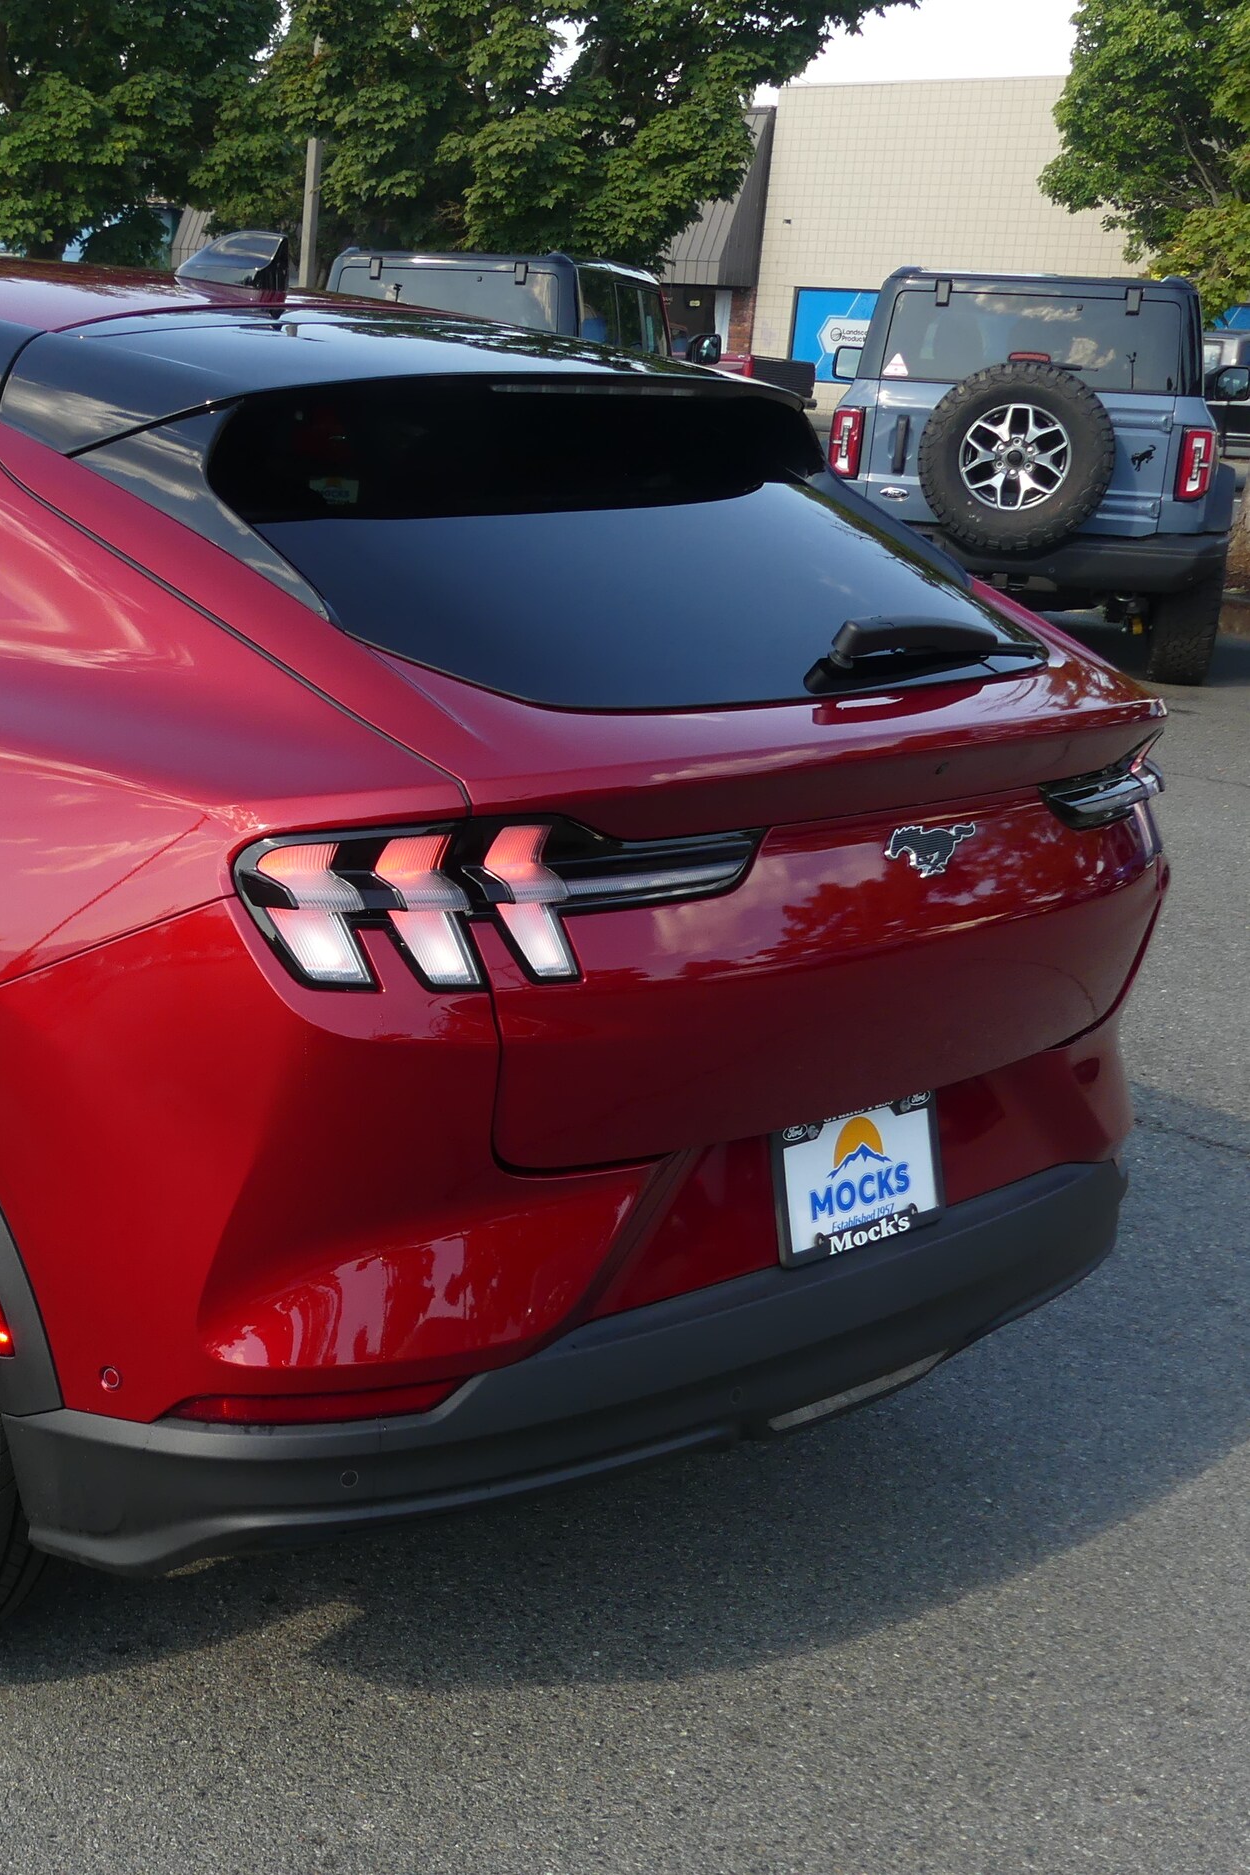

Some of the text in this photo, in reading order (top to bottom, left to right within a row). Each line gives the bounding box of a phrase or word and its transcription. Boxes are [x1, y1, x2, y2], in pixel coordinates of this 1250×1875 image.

[810, 1162, 911, 1223] MOCKS
[829, 1213, 911, 1256] Mock's
[832, 1202, 895, 1233] Established 1957
